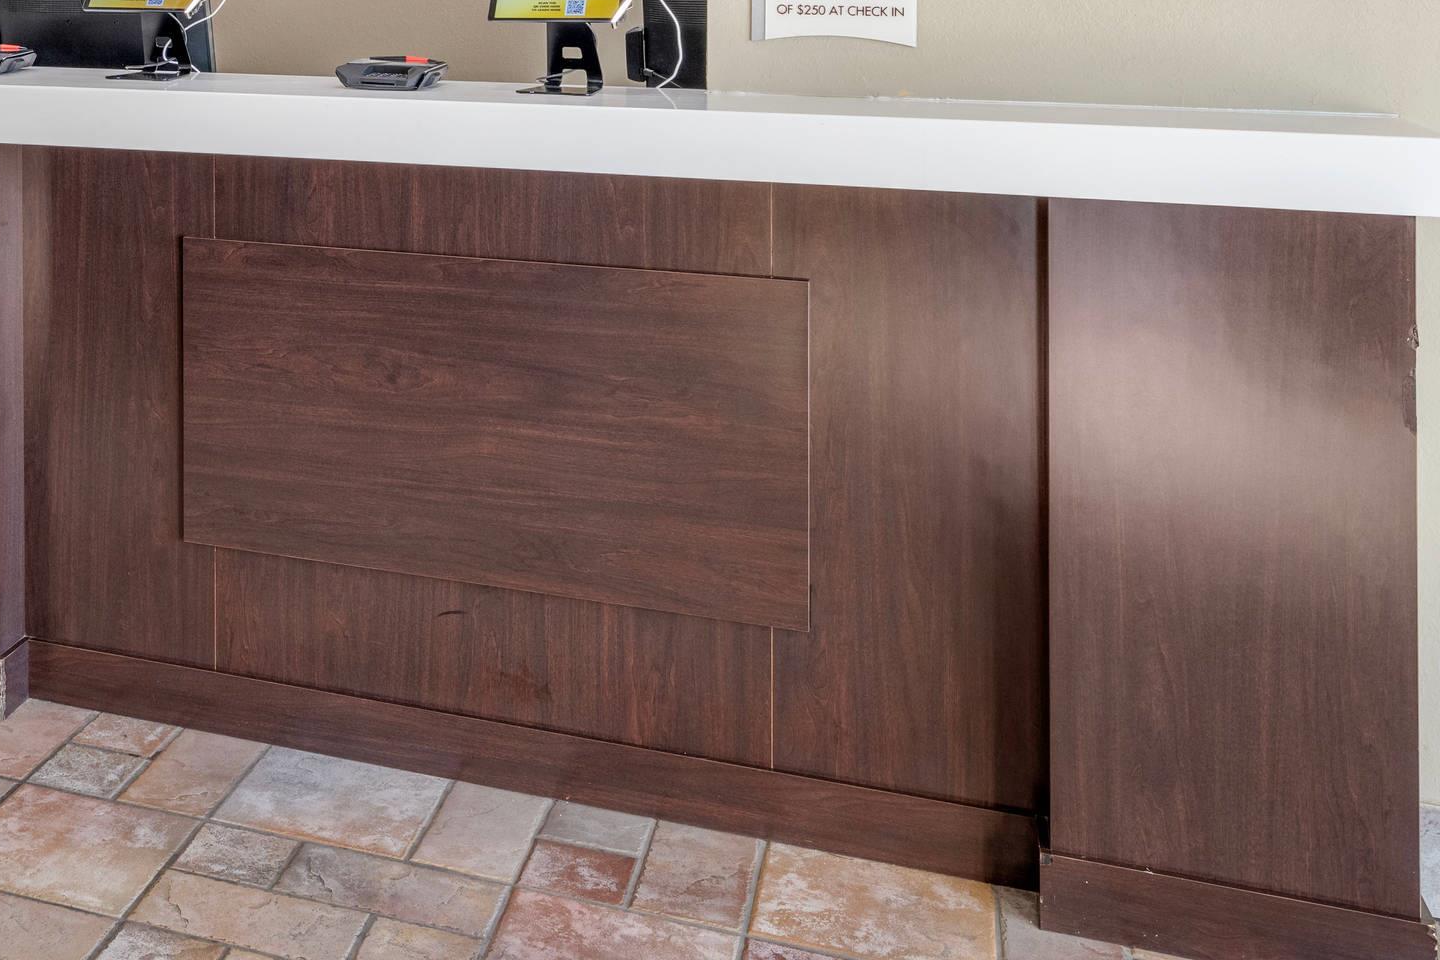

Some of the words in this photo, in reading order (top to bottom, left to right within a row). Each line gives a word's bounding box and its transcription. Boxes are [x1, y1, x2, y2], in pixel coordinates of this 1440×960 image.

[776, 4, 793, 14] OF
[797, 4, 826, 16] $250
[829, 6, 845, 16] AT
[847, 6, 888, 16] CHECK
[891, 7, 905, 17] IN
